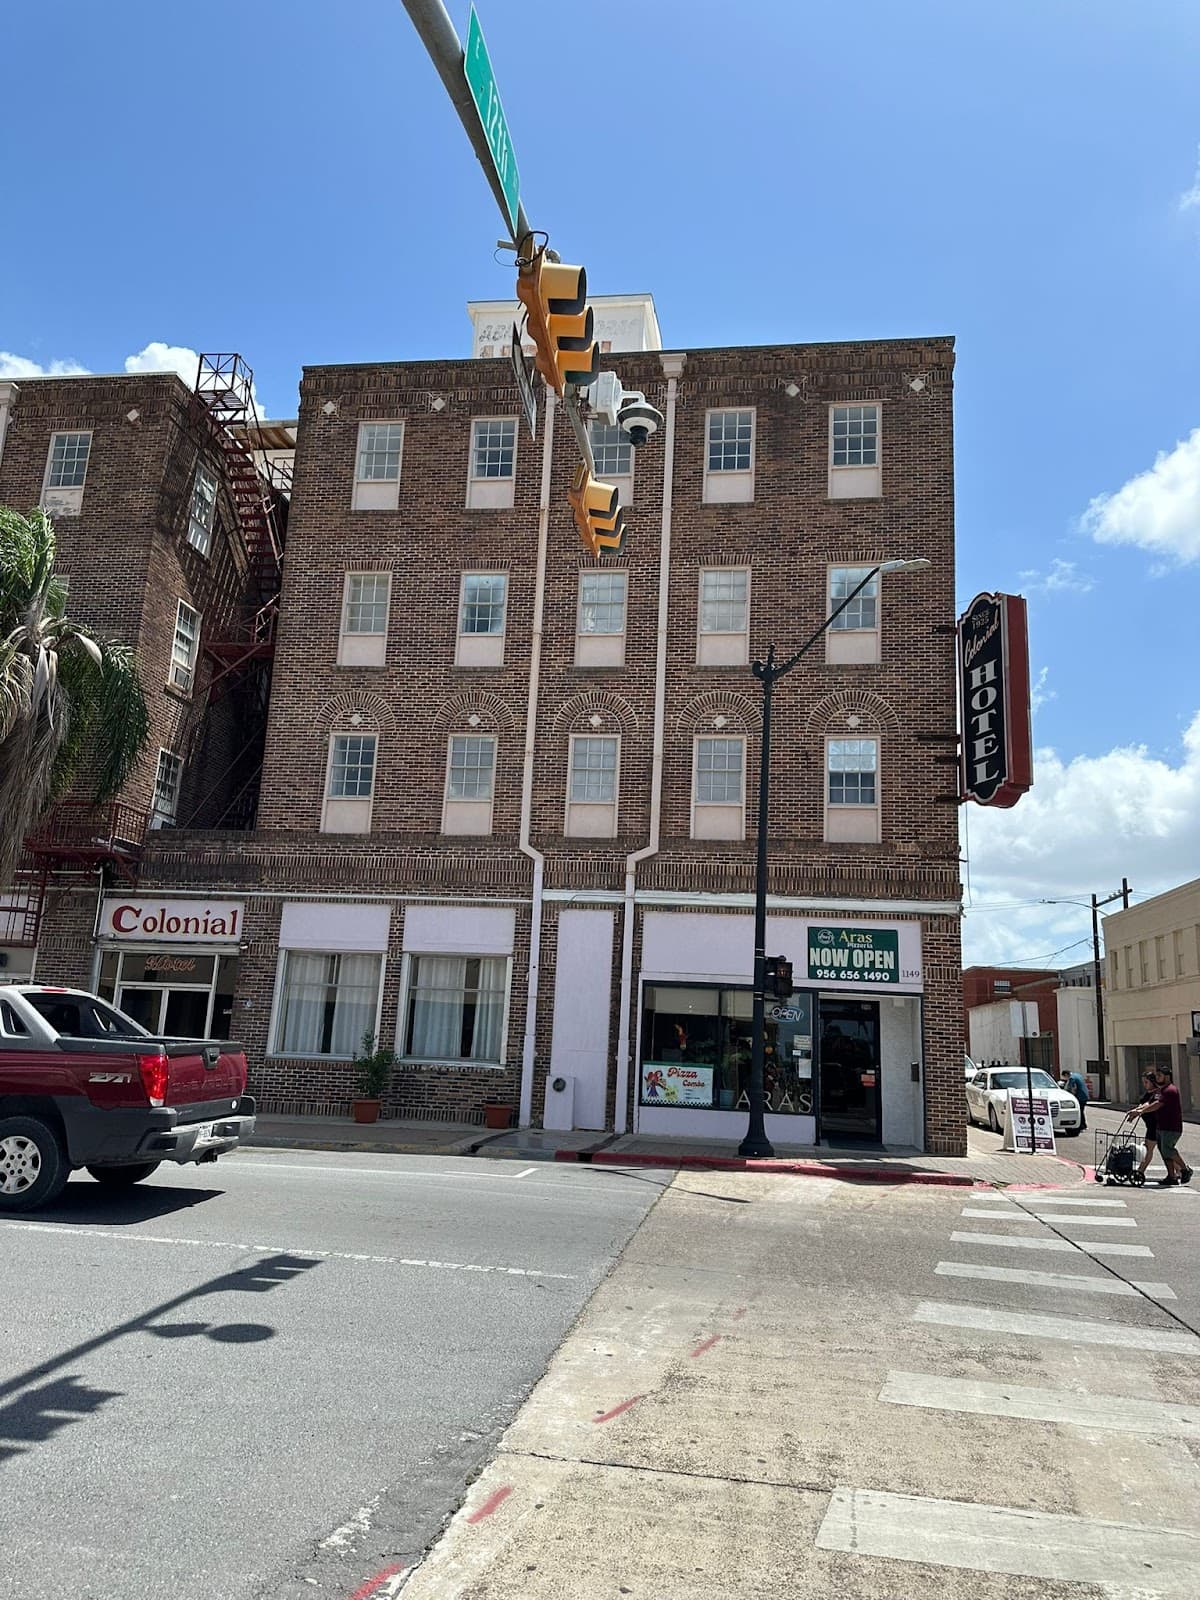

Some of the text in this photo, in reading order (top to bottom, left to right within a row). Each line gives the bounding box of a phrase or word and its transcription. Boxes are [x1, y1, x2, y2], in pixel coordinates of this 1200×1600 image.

[486, 80, 508, 183] 12th
[964, 609, 999, 668] Colonial
[969, 659, 1000, 785] HOTEL
[111, 905, 239, 936] Colonial
[838, 929, 873, 944] Aras
[809, 947, 895, 970] NOW OPEN
[816, 969, 890, 981] 956 656 1490
[901, 970, 920, 978] 1149
[771, 1006, 802, 1021] OPEN
[88, 1072, 132, 1084] Z71
[667, 1067, 698, 1079] Pizza
[682, 1079, 706, 1089] Combo
